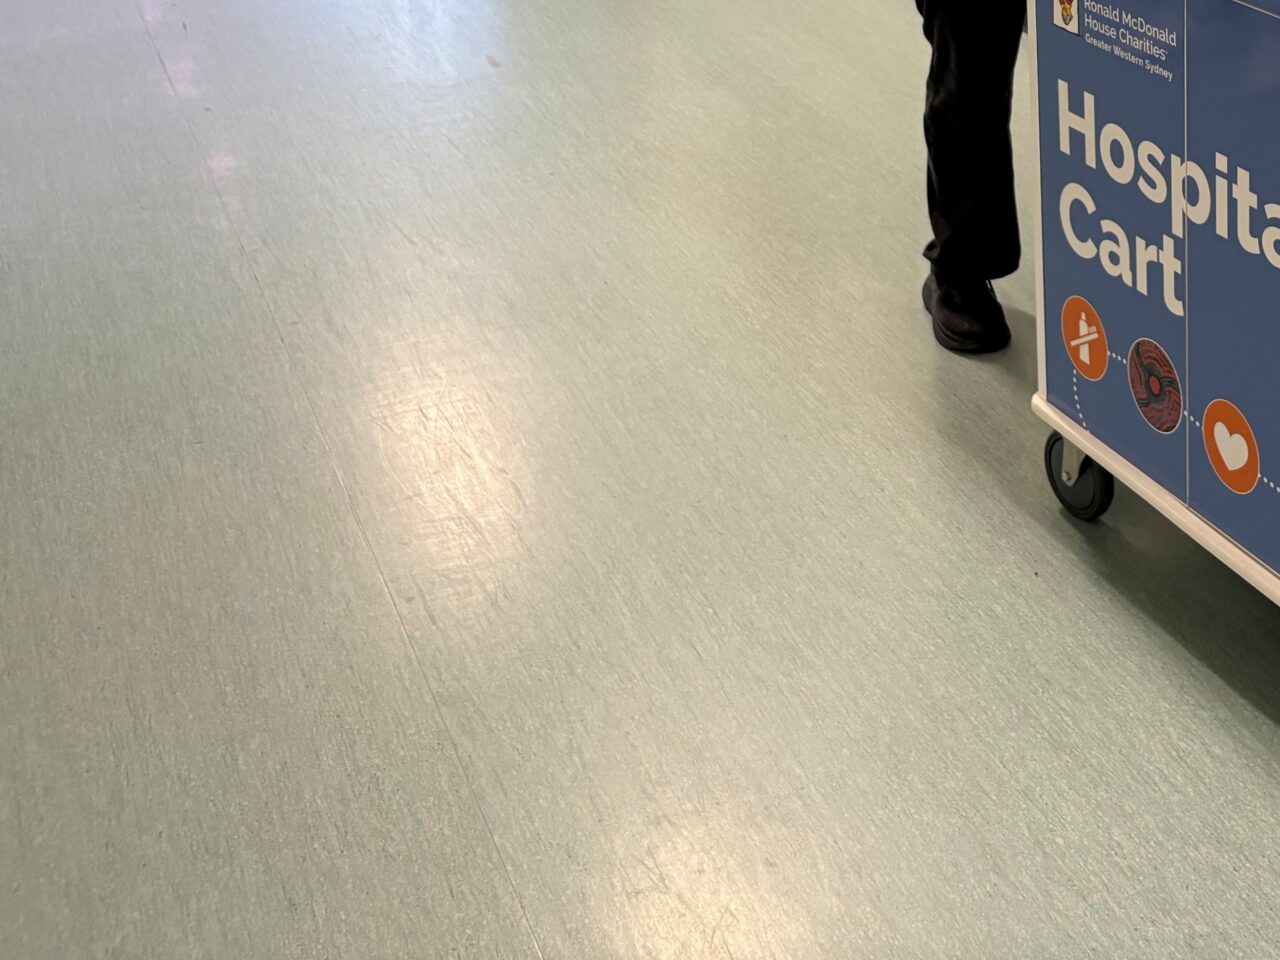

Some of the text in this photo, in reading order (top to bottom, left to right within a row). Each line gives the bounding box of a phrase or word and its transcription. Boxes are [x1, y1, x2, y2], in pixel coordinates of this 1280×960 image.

[1084, 13, 1166, 60] House Charities
[1122, 10, 1177, 47] McDonald
[1085, 33, 1173, 82] Greater Western Sydney
[1059, 182, 1184, 316] Cart
